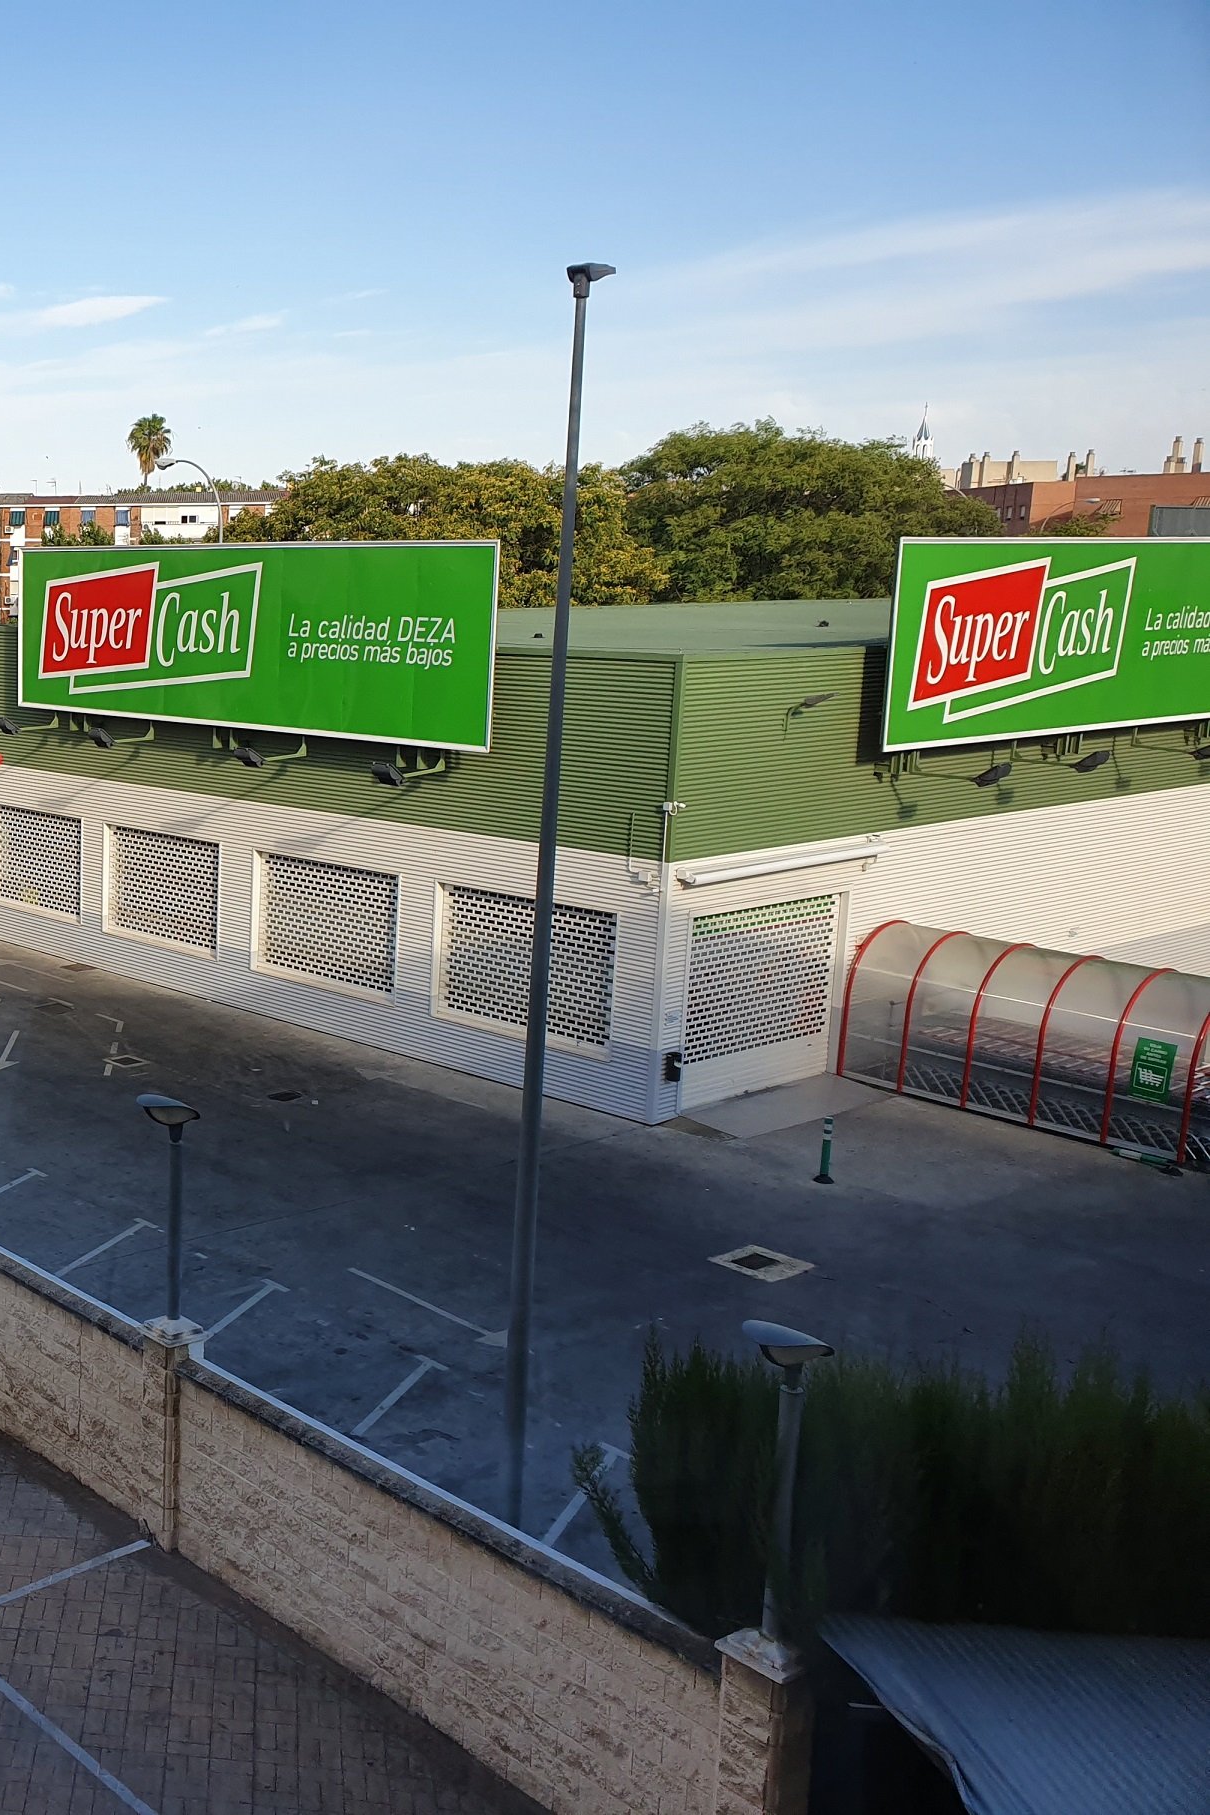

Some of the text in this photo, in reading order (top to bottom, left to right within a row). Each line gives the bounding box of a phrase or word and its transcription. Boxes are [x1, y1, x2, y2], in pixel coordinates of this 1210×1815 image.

[52, 591, 240, 667] Super Cash
[288, 613, 456, 644] La calidad DEZA
[1144, 607, 1163, 631] La
[926, 589, 1114, 684] Super Cash
[1141, 633, 1210, 661] a precios má
[287, 638, 453, 670] a precios más bajos
